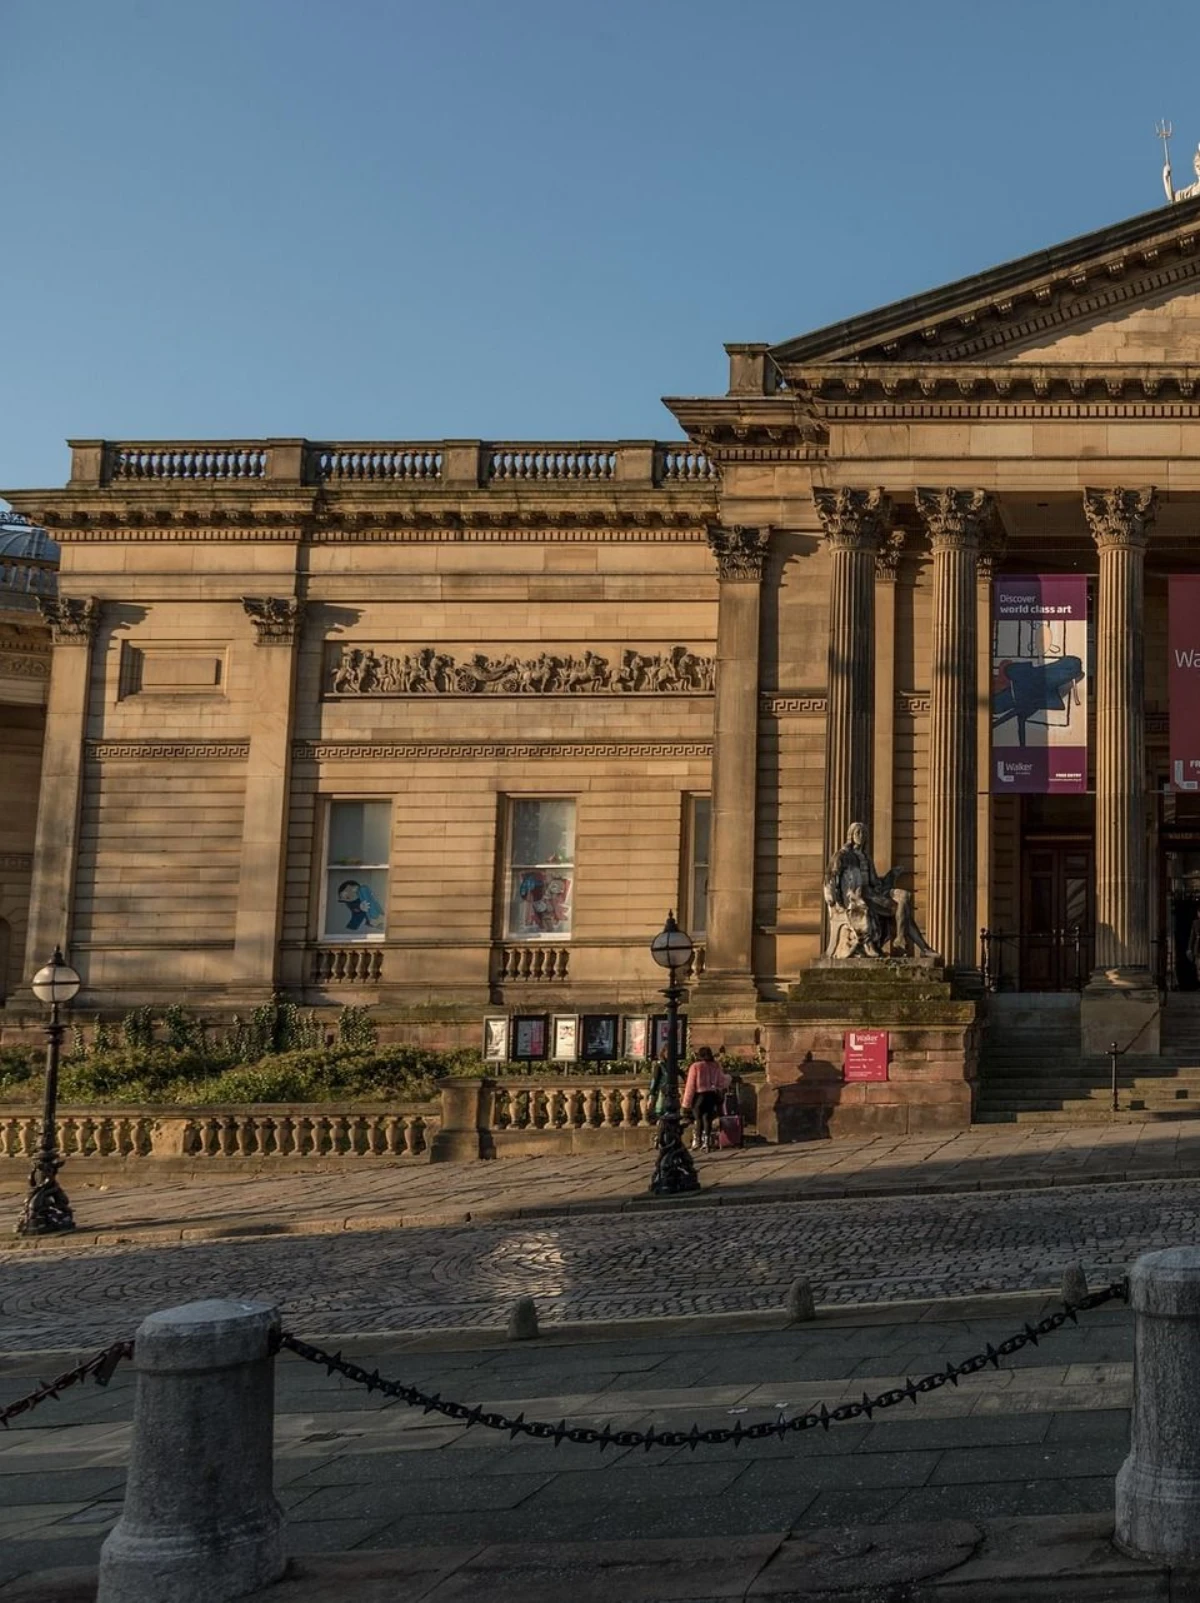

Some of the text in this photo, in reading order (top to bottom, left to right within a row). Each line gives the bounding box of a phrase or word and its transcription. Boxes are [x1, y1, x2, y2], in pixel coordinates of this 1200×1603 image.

[1000, 594, 1036, 603] Discover
[1000, 605, 1072, 614] world class art
[1005, 762, 1033, 771] Walker
[856, 1034, 878, 1042] Walker
